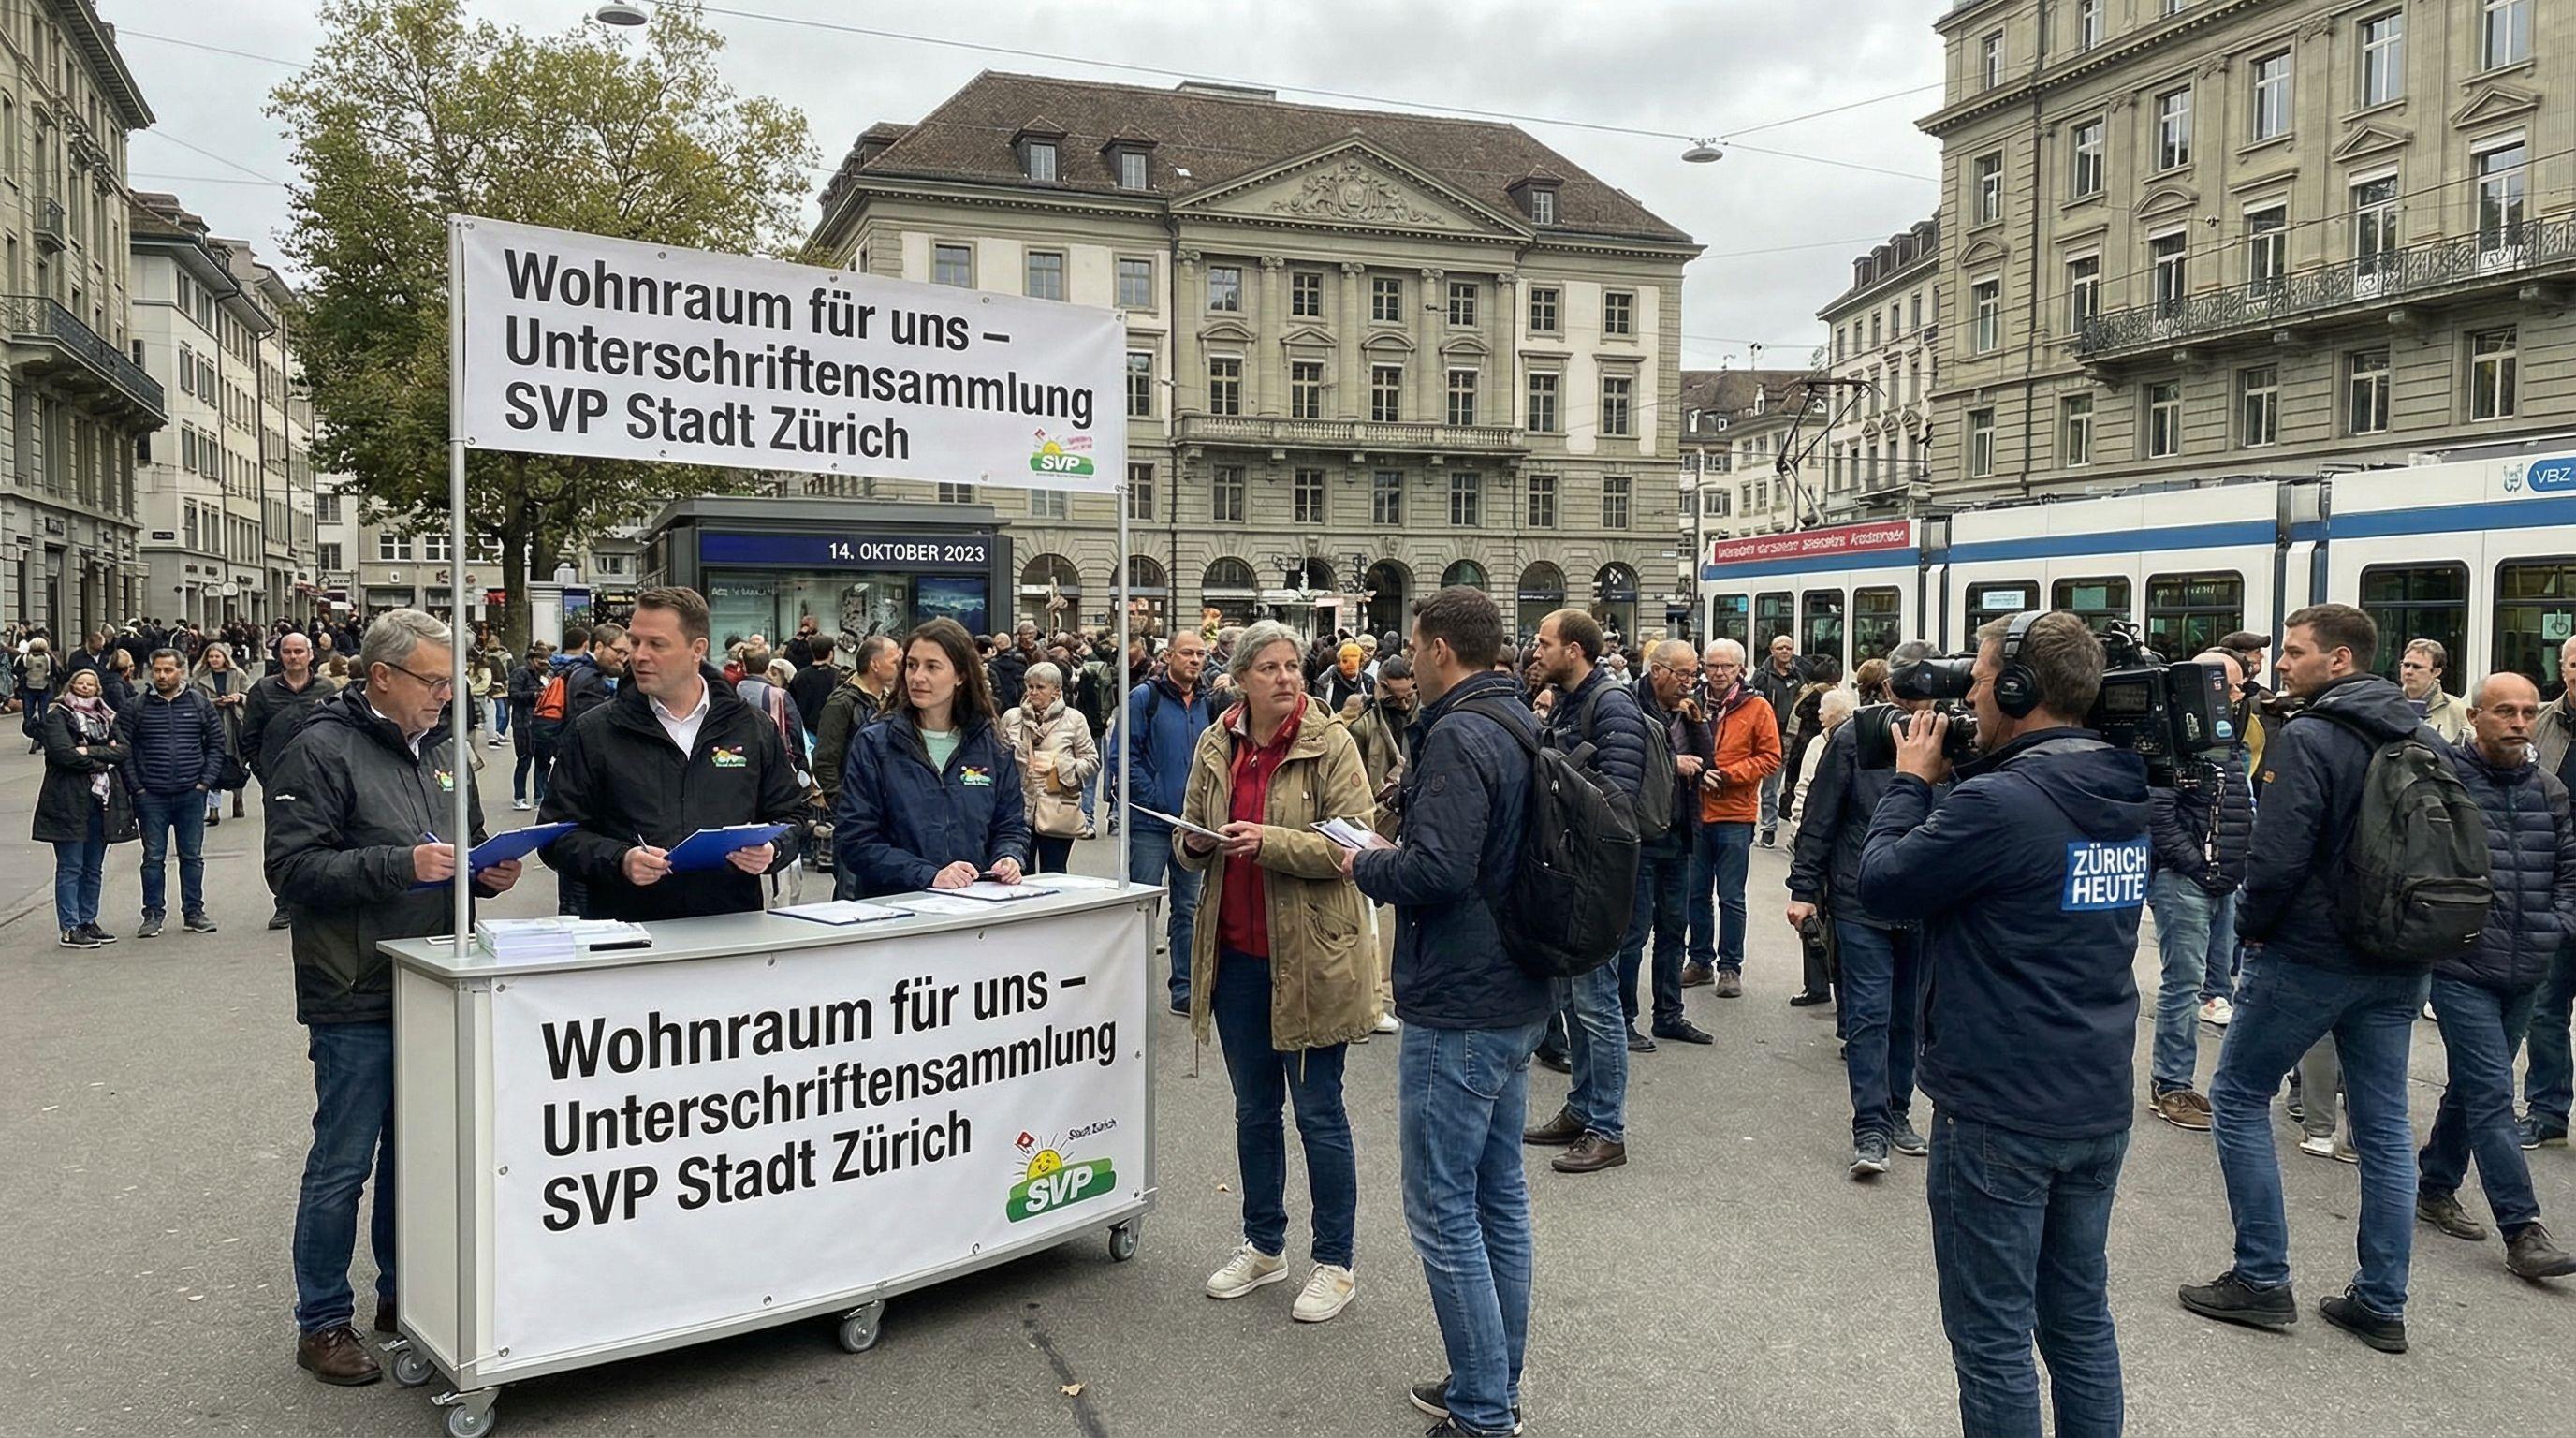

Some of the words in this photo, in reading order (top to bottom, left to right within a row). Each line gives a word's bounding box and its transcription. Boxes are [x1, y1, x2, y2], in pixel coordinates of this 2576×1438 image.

[504, 248, 791, 330] Wohnraum
[808, 287, 876, 340] für
[891, 309, 969, 351] uns
[506, 315, 1093, 430] Unterschriftensammlung
[505, 381, 608, 434] SVP
[626, 392, 756, 448] Stadt
[769, 405, 909, 460] Zürich
[1041, 455, 1080, 471] SVP
[2536, 467, 2572, 484] VBZ
[829, 542, 855, 560] 14.
[859, 543, 939, 561] OKTOBER
[944, 545, 985, 562] 2023
[2071, 873, 2145, 904] HEUTE
[2073, 843, 2147, 876] ZÜRICH
[541, 999, 872, 1081] Wohnraum
[889, 976, 959, 1035] für
[974, 971, 1048, 1020] uns
[544, 1020, 1116, 1157] Unterschriftensammlung
[543, 1166, 658, 1232] SVP
[677, 1139, 816, 1211] Stadt
[832, 1109, 971, 1183] Zürich
[1026, 1166, 1093, 1212] SVP
